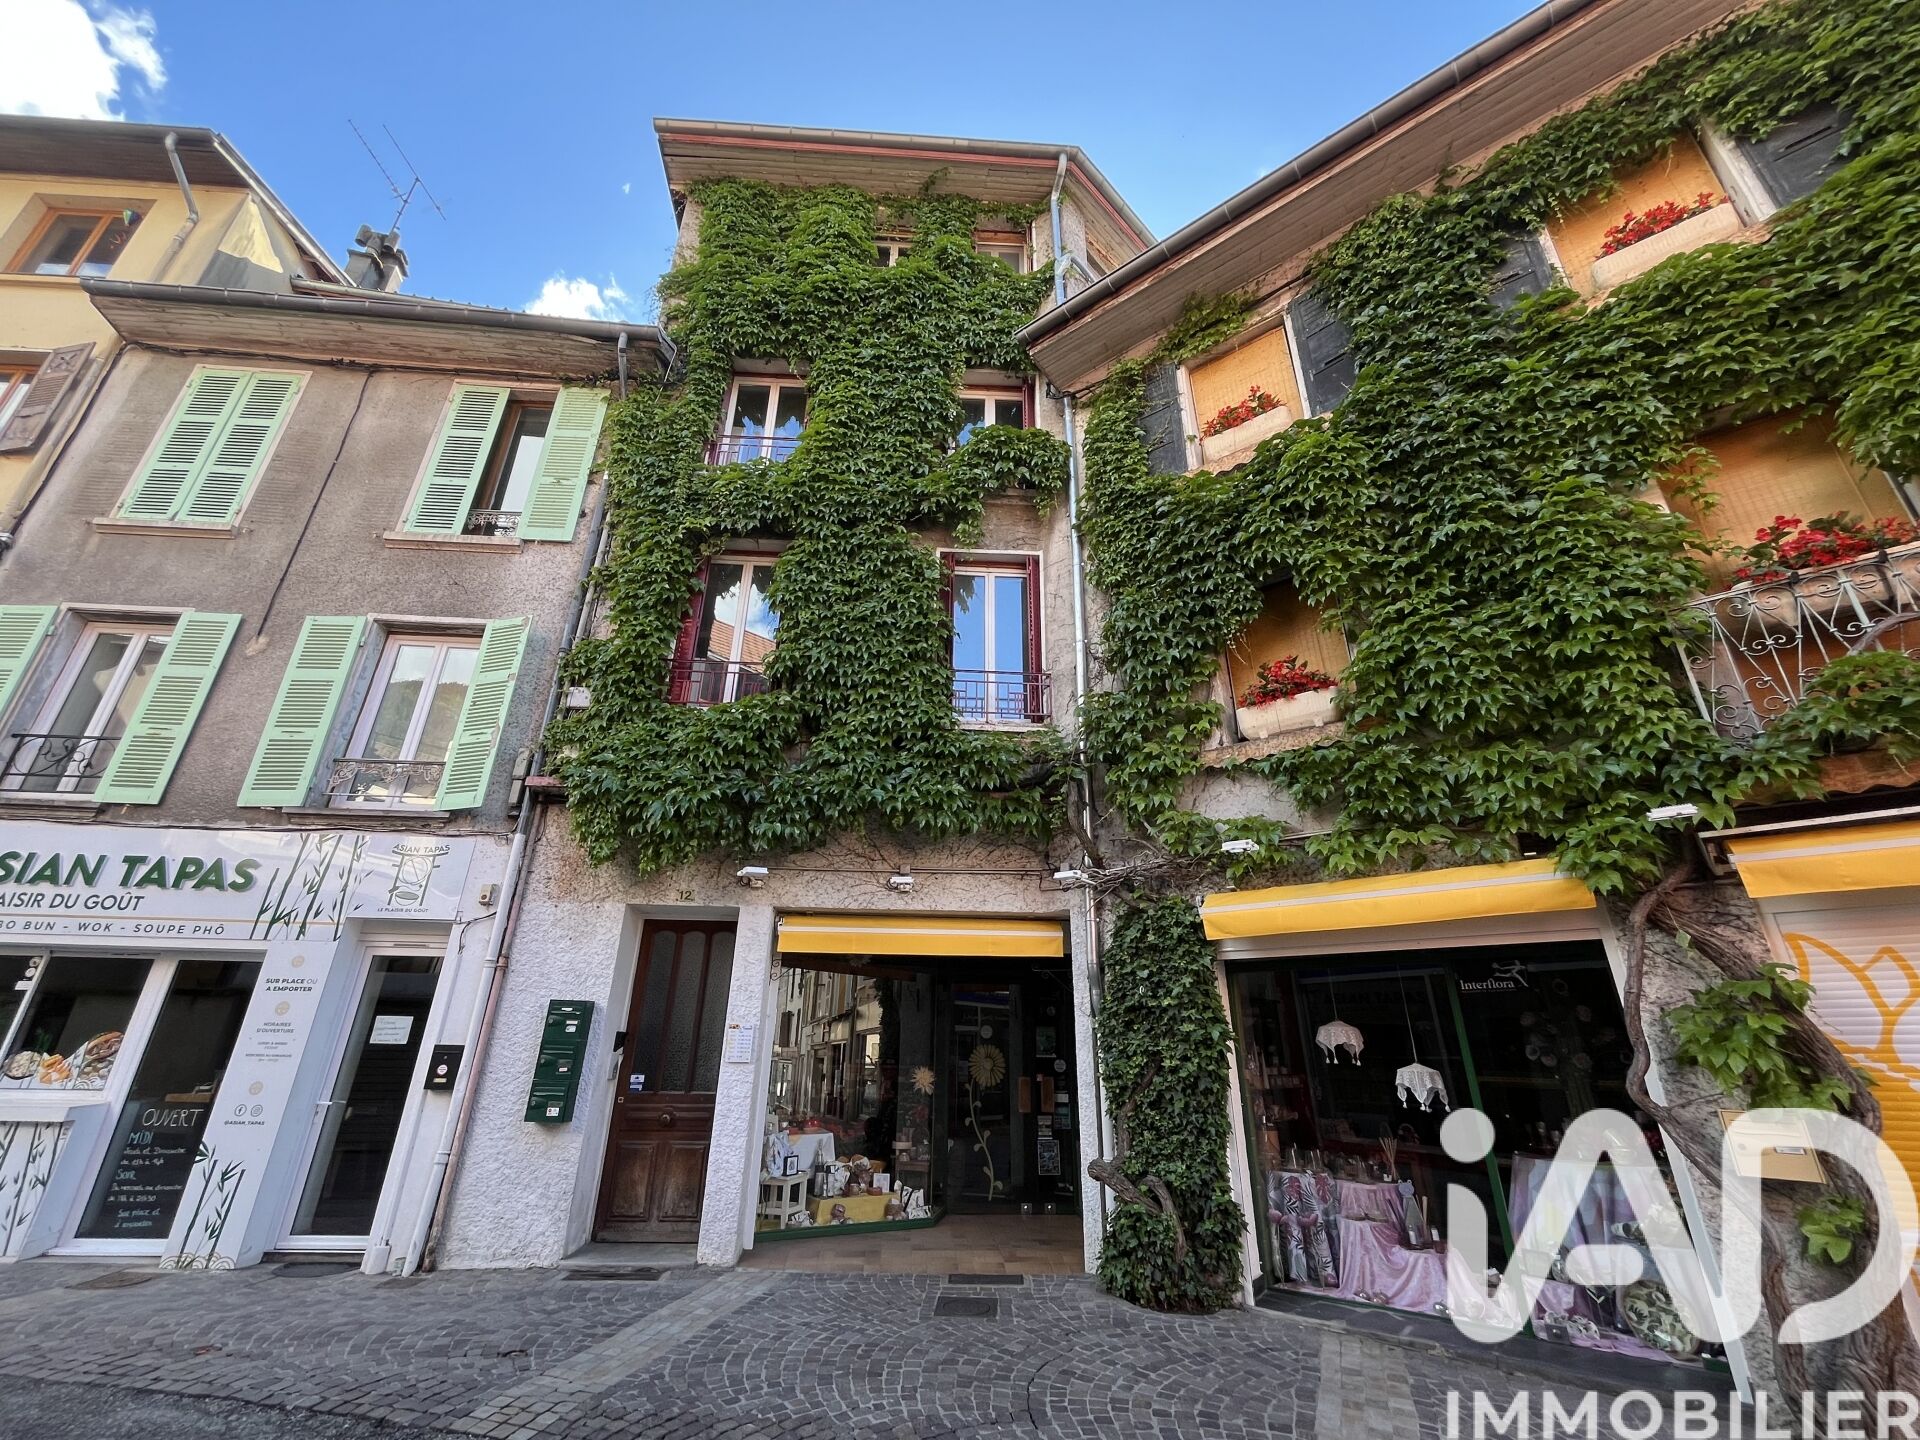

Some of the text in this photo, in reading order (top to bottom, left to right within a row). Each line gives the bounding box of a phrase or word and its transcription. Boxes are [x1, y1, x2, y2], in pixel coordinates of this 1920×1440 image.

[393, 843, 451, 853] ASIAN TAPAS
[119, 855, 262, 892] TAPAS
[48, 893, 80, 910] DU
[84, 891, 145, 911] GOÛT
[680, 890, 692, 900] 12
[23, 921, 56, 931] BUN
[78, 922, 113, 932] WOK
[133, 923, 187, 934] SOUPE
[192, 923, 225, 935] PHÔ
[1460, 977, 1516, 990] Interflora
[142, 1108, 205, 1127] OUVERT
